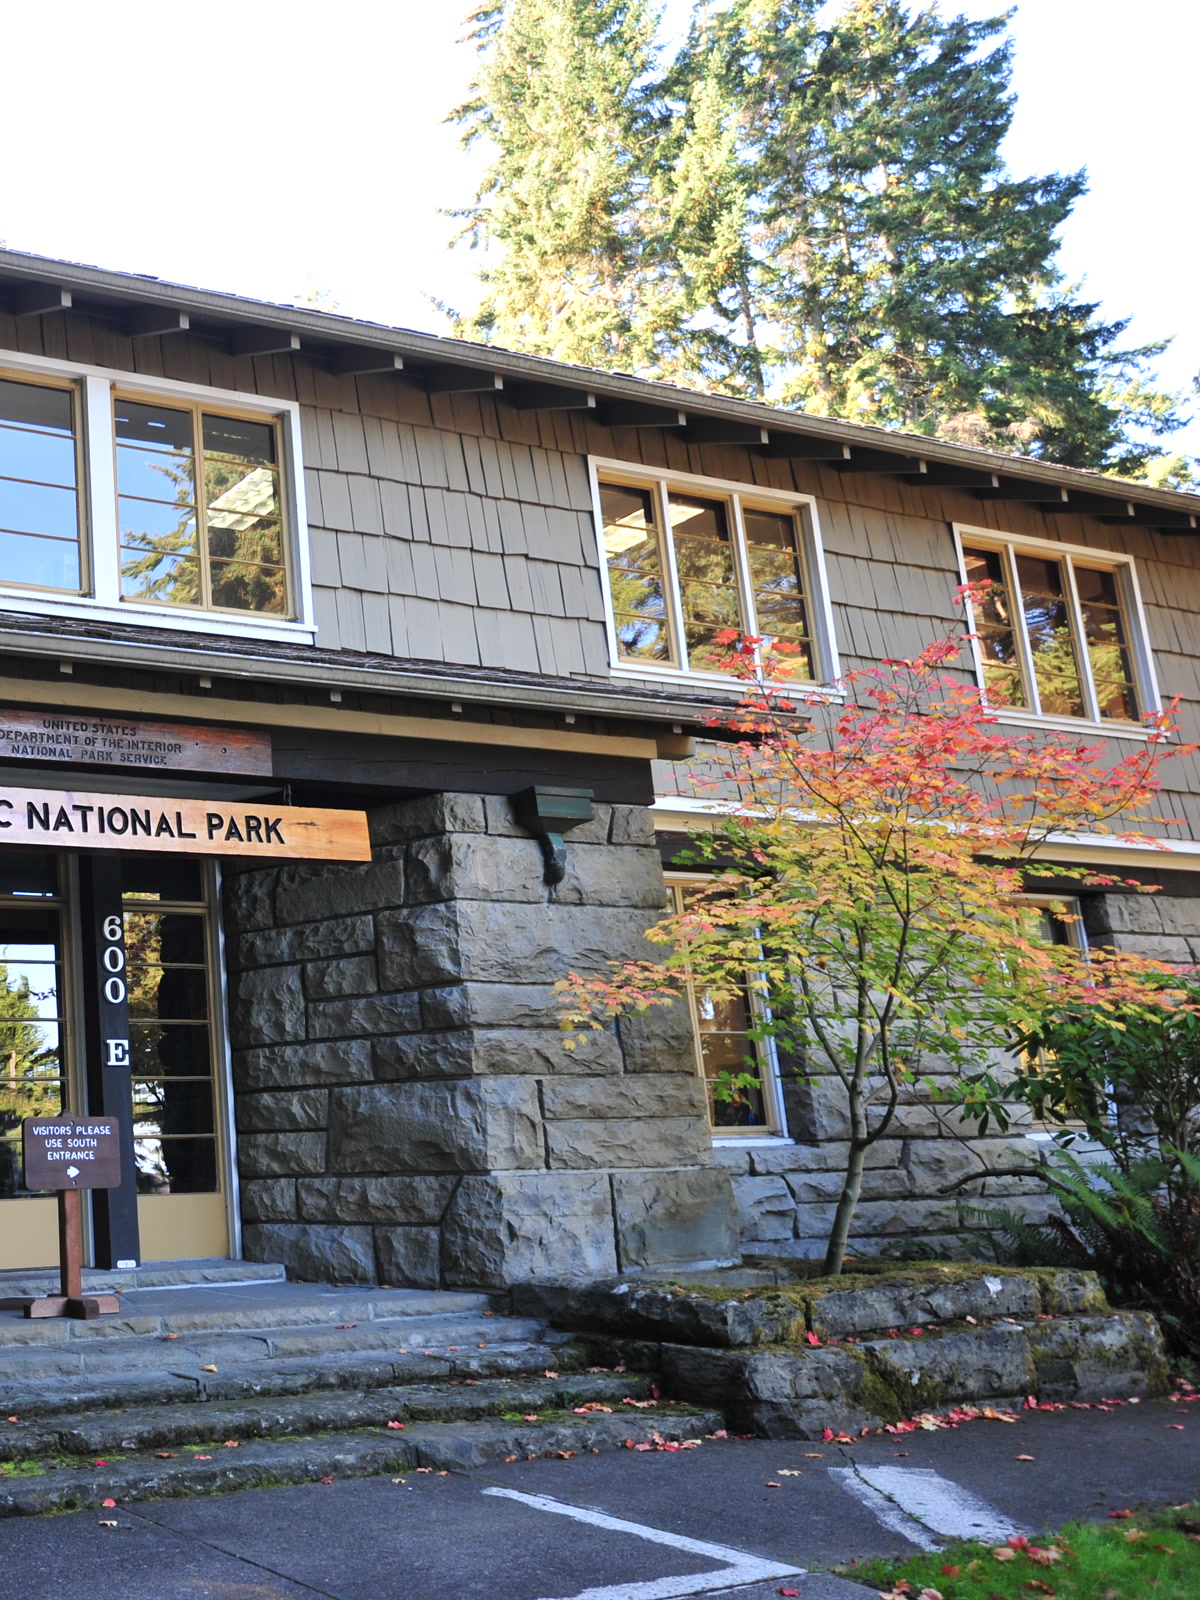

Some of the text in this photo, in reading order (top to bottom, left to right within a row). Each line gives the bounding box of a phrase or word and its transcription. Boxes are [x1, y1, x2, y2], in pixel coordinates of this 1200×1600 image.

[43, 719, 137, 737] UNITED STATES
[84, 736, 98, 746] OF
[101, 737, 124, 749] THE
[127, 740, 182, 753] INTERIOR
[11, 744, 167, 765] NATIONAL PARK SERVICE
[27, 801, 197, 839] NATIONAL
[207, 812, 286, 844] PARK
[102, 915, 126, 1005] 600
[105, 1038, 130, 1067] E
[32, 1125, 111, 1136] VISITORS PLEASE
[45, 1138, 98, 1148] USE SOUTH
[47, 1151, 95, 1160] ENTRANCE
